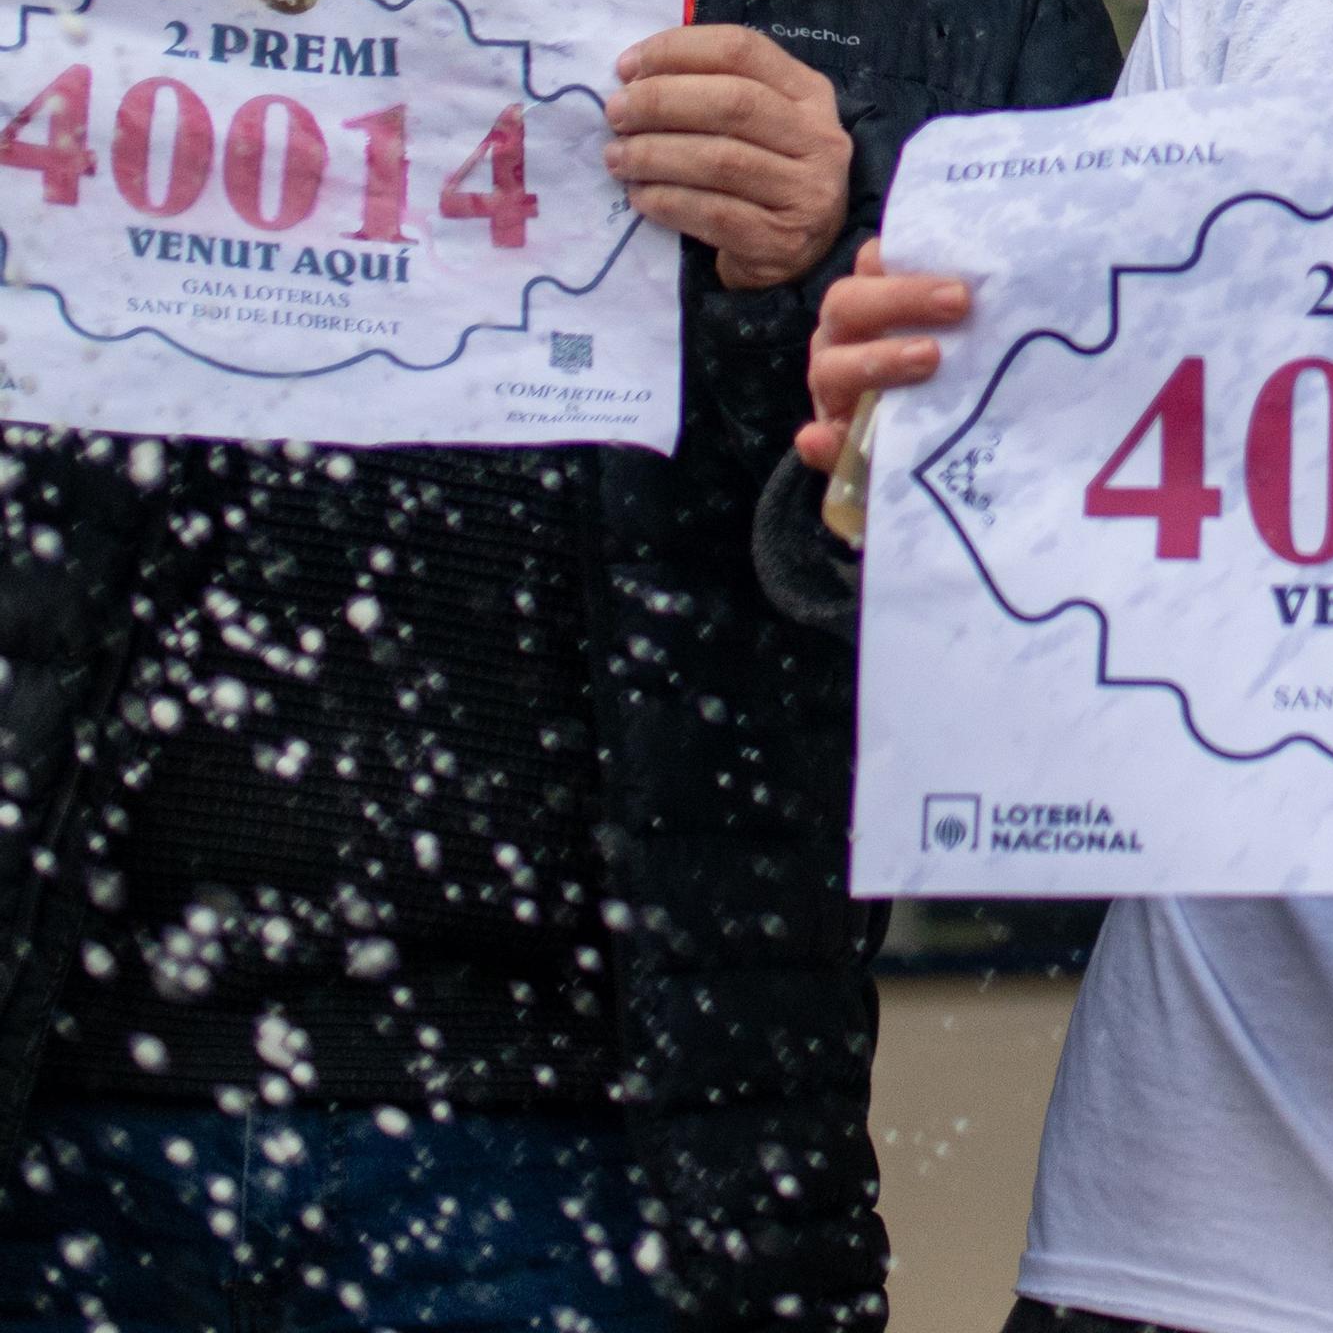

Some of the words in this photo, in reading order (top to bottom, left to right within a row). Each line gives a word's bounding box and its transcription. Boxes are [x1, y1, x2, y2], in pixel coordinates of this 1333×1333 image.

[209, 22, 400, 78] PREMI
[771, 23, 861, 46] Quechua
[0, 63, 539, 249] 40014
[945, 154, 1067, 183] LOTERIA
[1075, 148, 1114, 171] DE
[1121, 141, 1225, 166] NADAL
[126, 225, 281, 272] VENUT
[290, 246, 411, 287] AQUÍ
[182, 278, 238, 300] GAIA
[244, 283, 351, 309] LOTERIAS
[126, 296, 189, 316] SANT
[192, 301, 232, 321] BOI
[236, 305, 269, 324] DE
[272, 308, 402, 335] LLOBREGAT
[992, 797, 1113, 827] LOTERÍA
[991, 829, 1144, 853] NACIONAL
